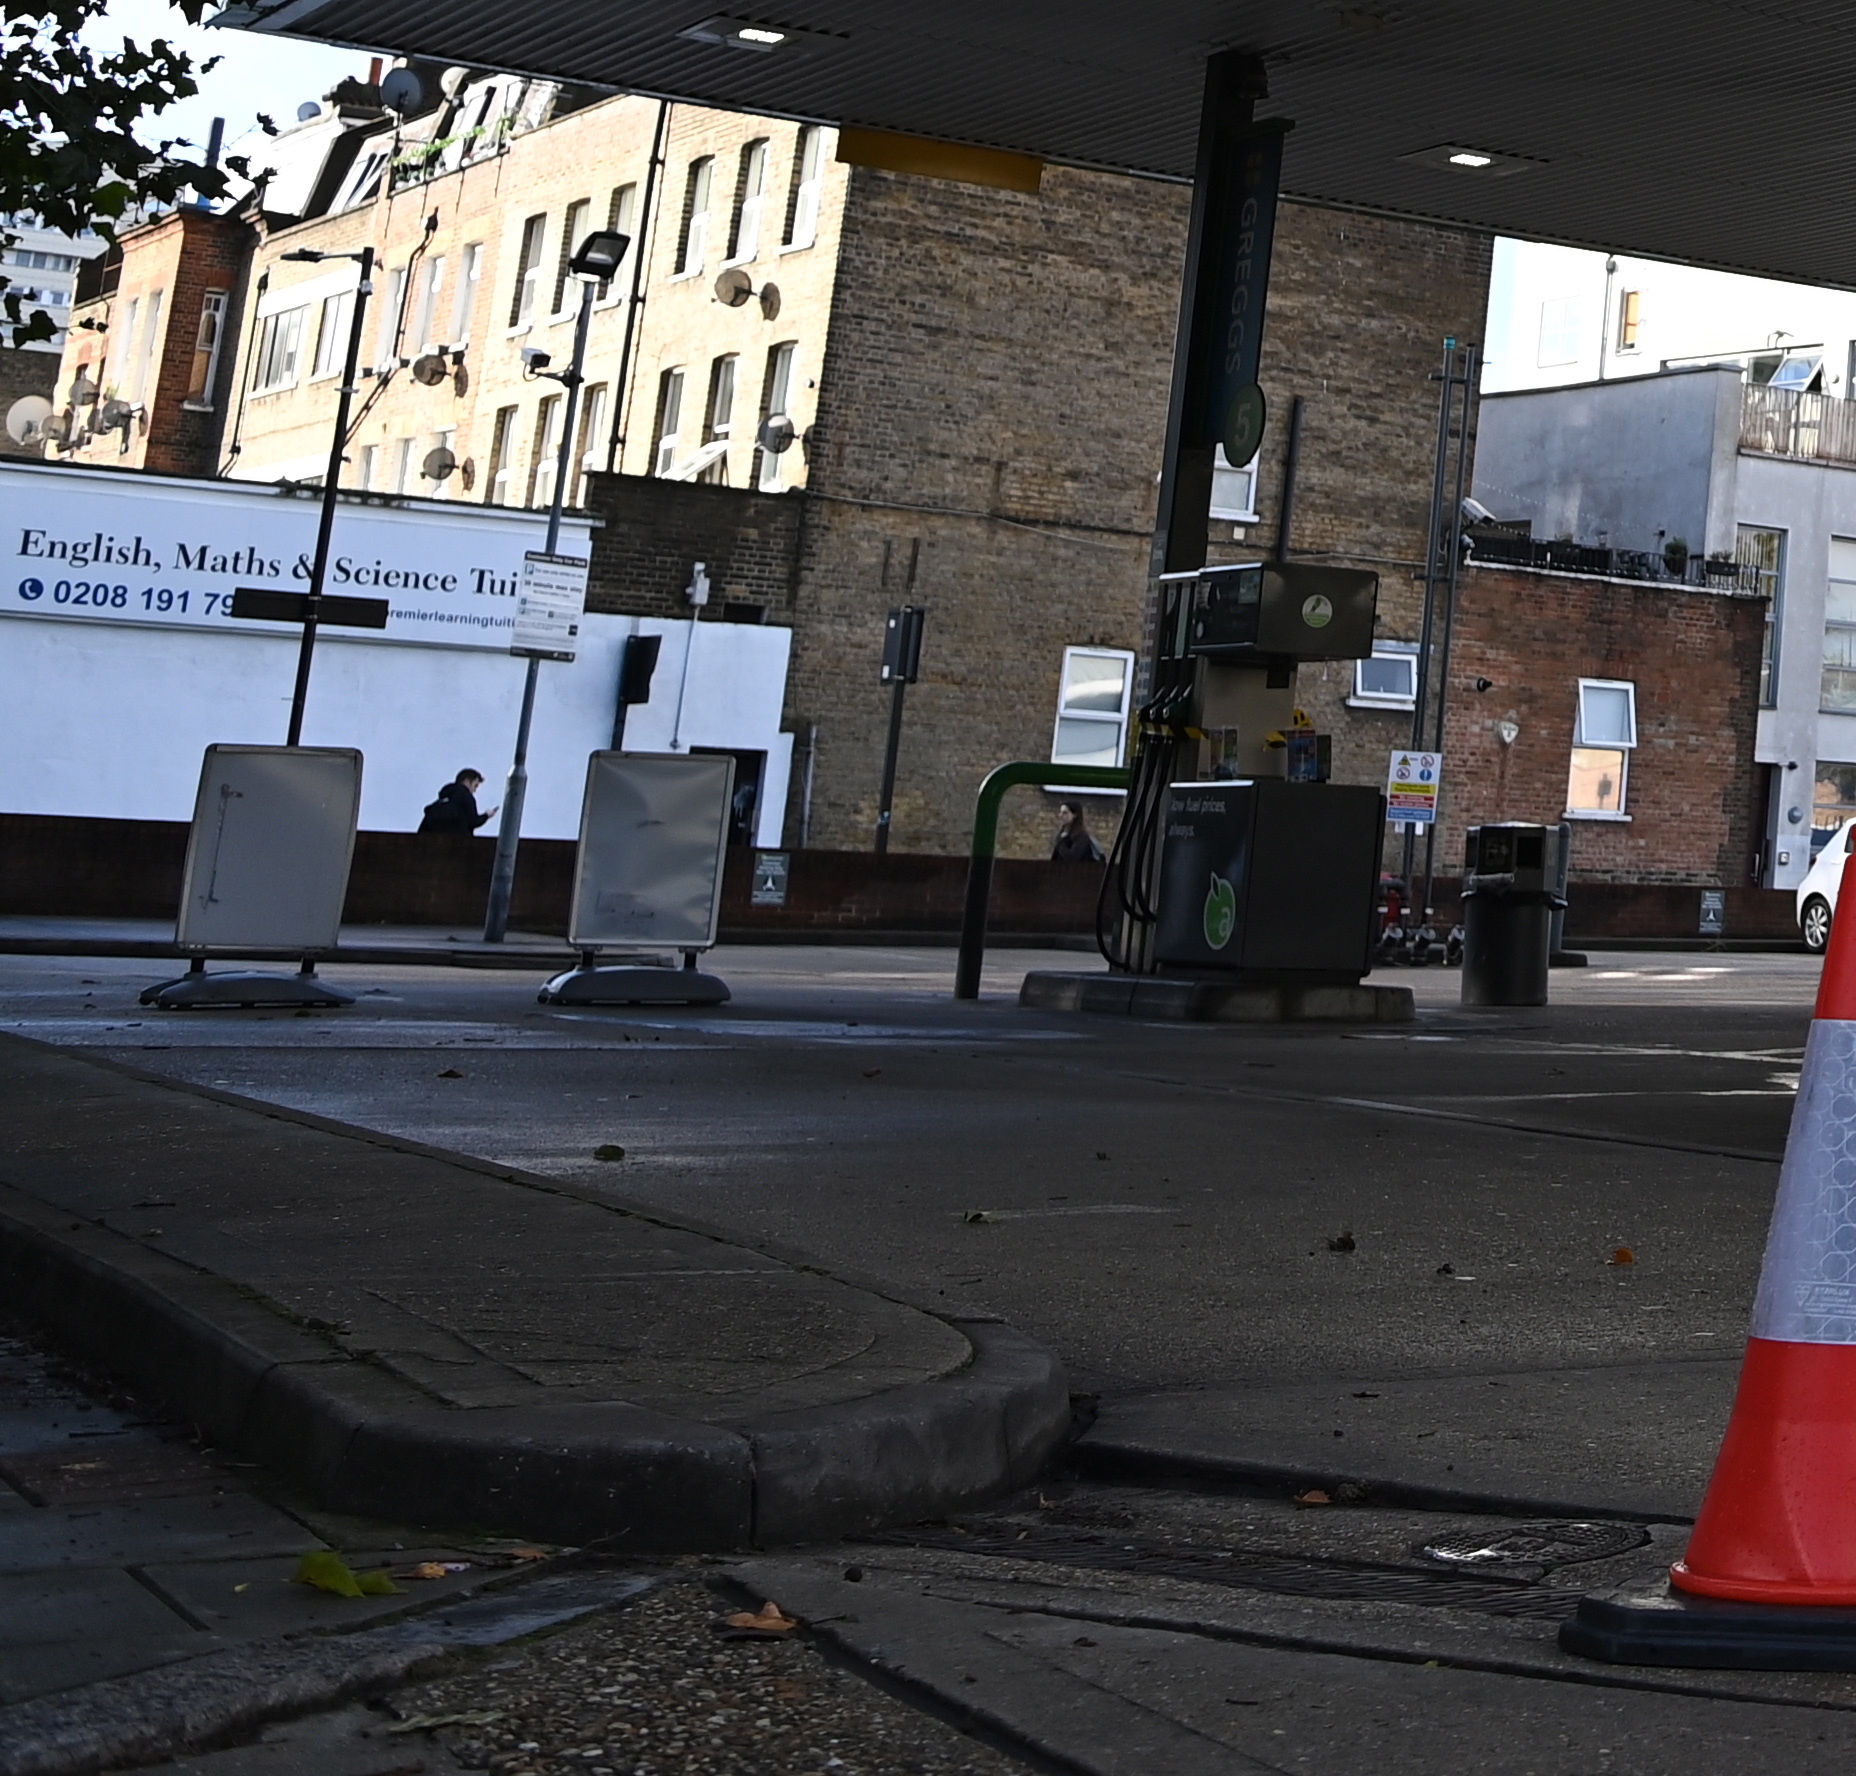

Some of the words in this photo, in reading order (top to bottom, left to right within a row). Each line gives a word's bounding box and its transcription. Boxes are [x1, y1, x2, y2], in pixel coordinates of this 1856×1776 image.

[1225, 196, 1258, 374] GREGGS
[1233, 401, 1250, 446] 5
[17, 528, 162, 574] English,
[172, 542, 281, 579] Maths
[292, 552, 314, 581] &
[332, 556, 458, 593] Science
[470, 567, 517, 597] Tui
[54, 579, 128, 609] 0208
[140, 587, 190, 613] 191
[203, 592, 236, 617] 79
[388, 607, 516, 629] remierlearningtuiti
[1186, 796, 1201, 812] fuel
[1201, 795, 1226, 814] prices,
